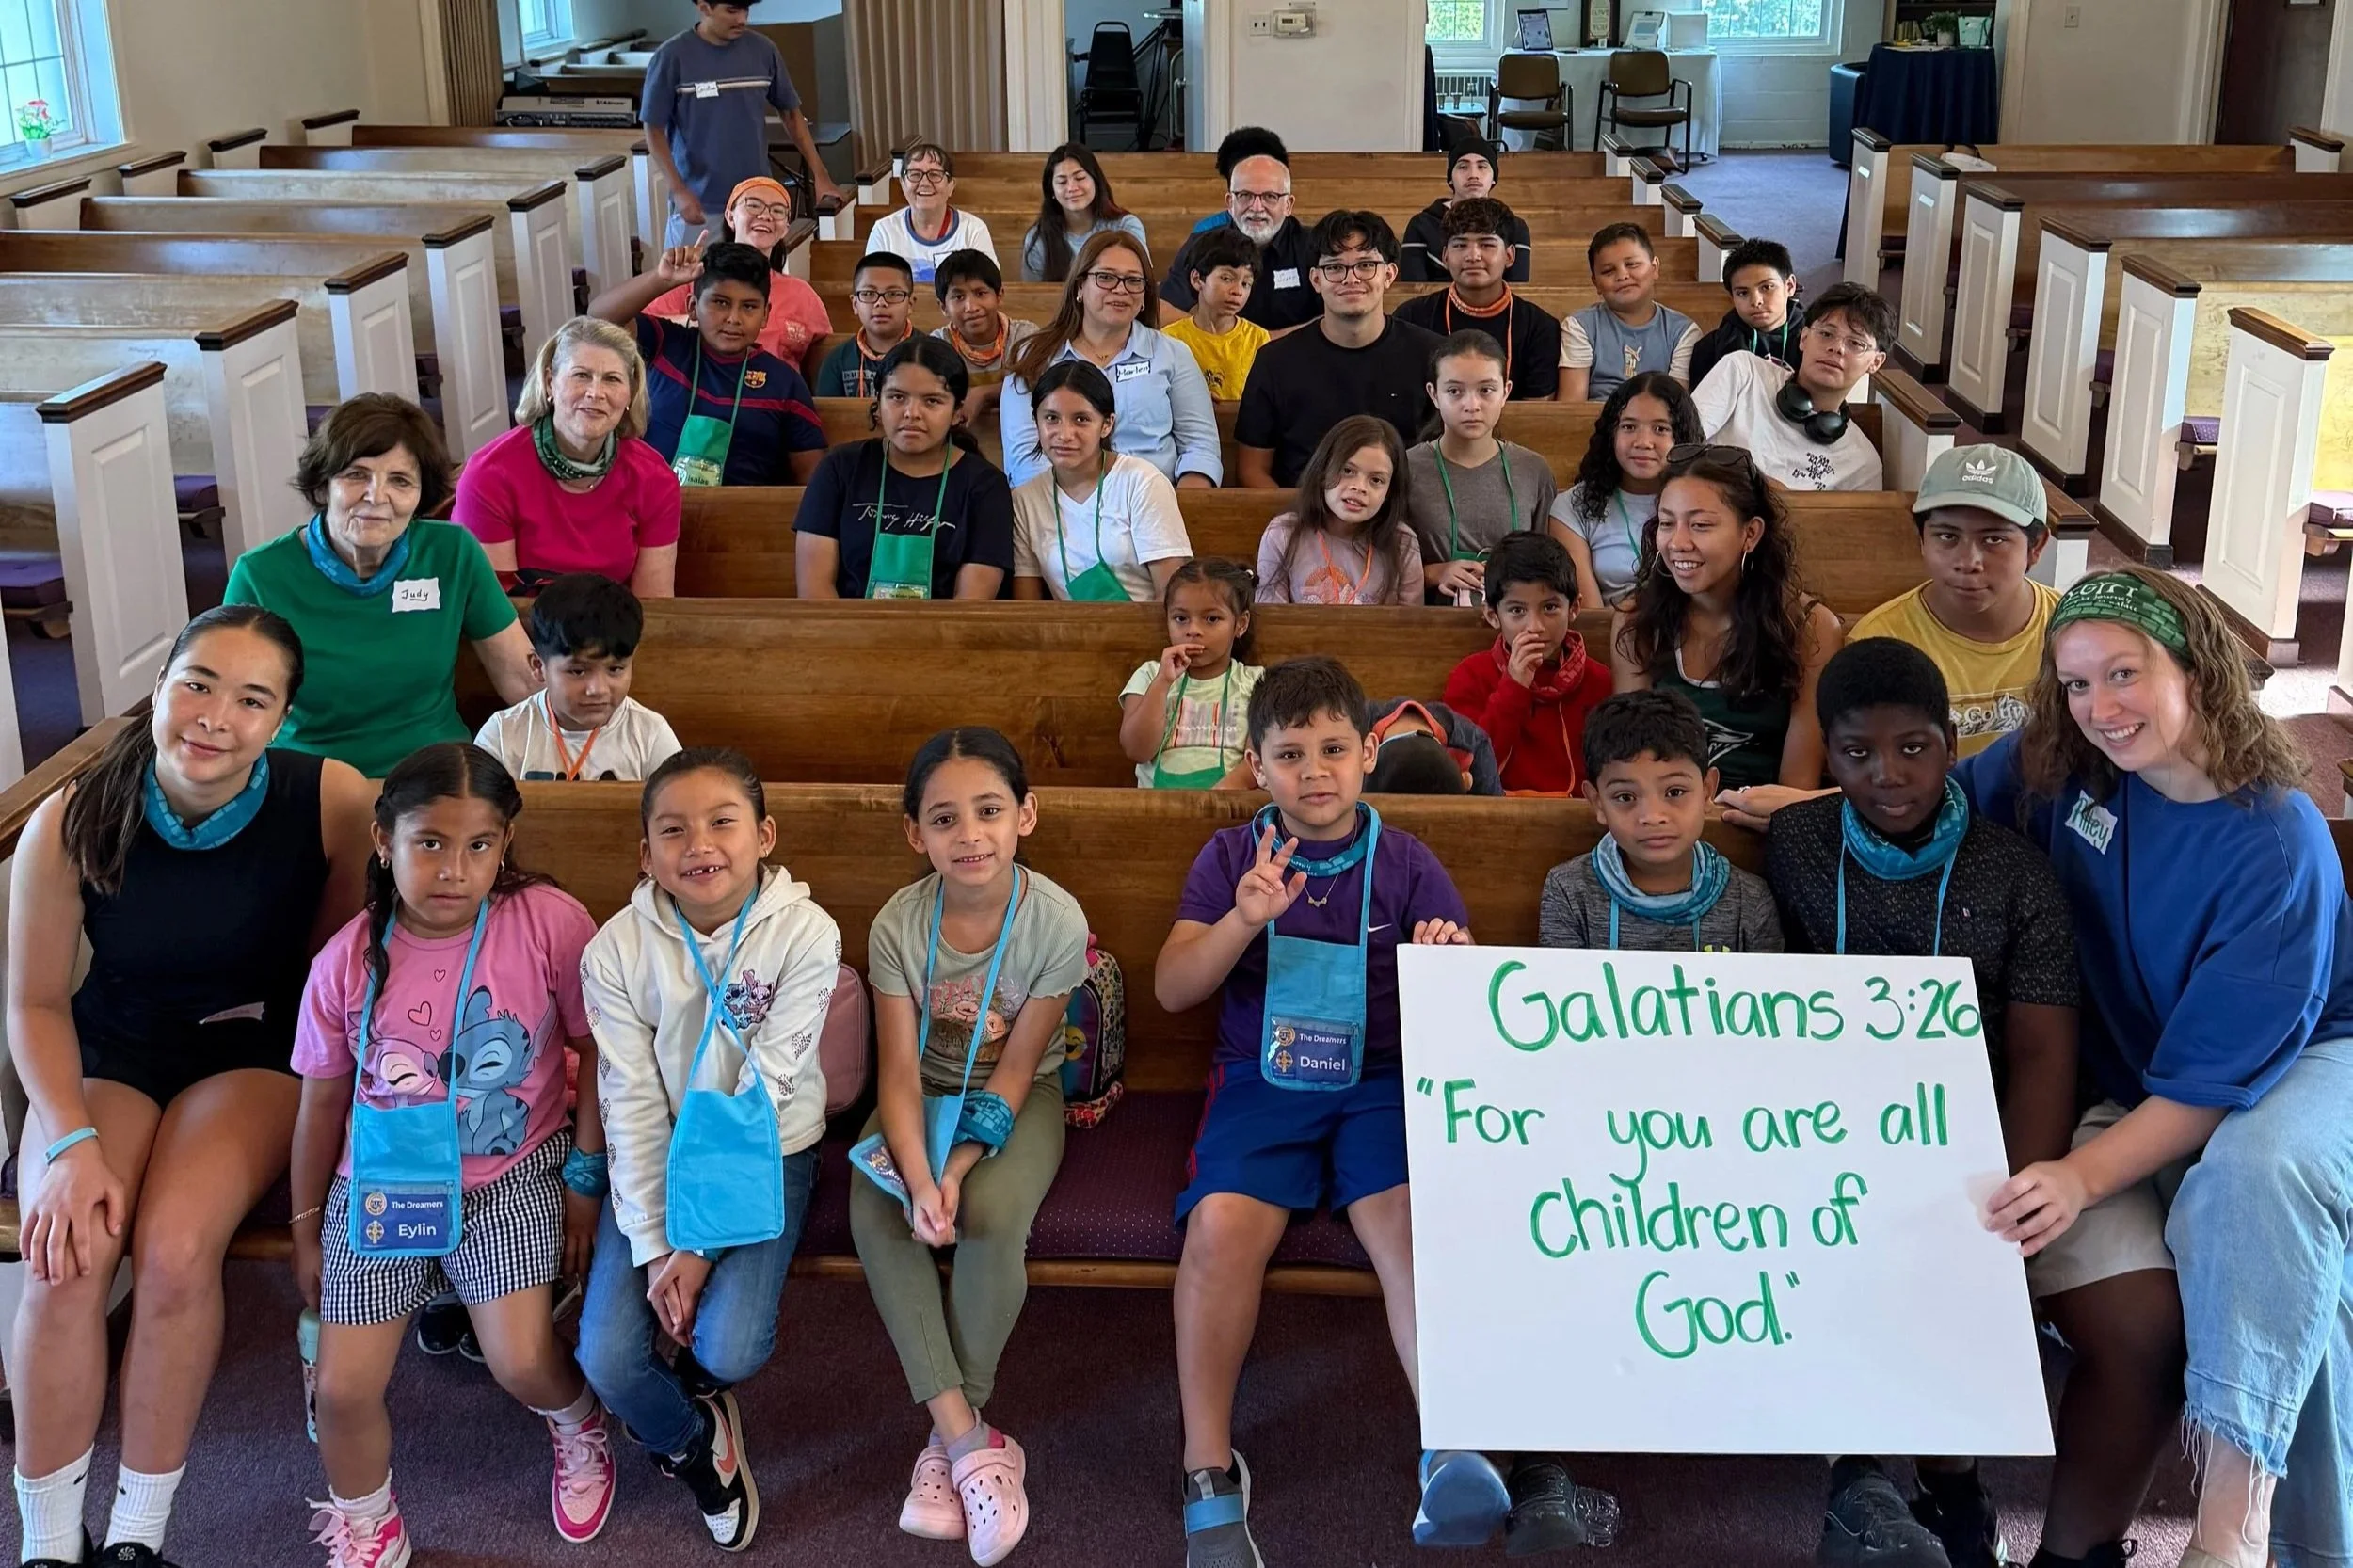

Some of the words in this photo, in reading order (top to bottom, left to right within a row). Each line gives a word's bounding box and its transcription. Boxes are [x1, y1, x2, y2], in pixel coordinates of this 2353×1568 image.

[1962, 474, 1993, 484] adidas
[401, 588, 429, 602] Judy
[1488, 960, 1844, 1052] Galatians
[1865, 976, 1981, 1041] 3:26
[1299, 1033, 1312, 1042] The
[1314, 1034, 1347, 1045] Dreamers
[1300, 1055, 1346, 1071] Daniel
[1417, 1077, 1545, 1145] "For
[1607, 1109, 1713, 1186] you
[1742, 1101, 1848, 1153] are
[1879, 1081, 1948, 1146] all
[391, 1201, 405, 1209] The
[407, 1200, 444, 1209] Dreamers
[1811, 1172, 1868, 1247] of
[398, 1222, 437, 1240] Eylin
[1635, 1269, 1800, 1359] God."
